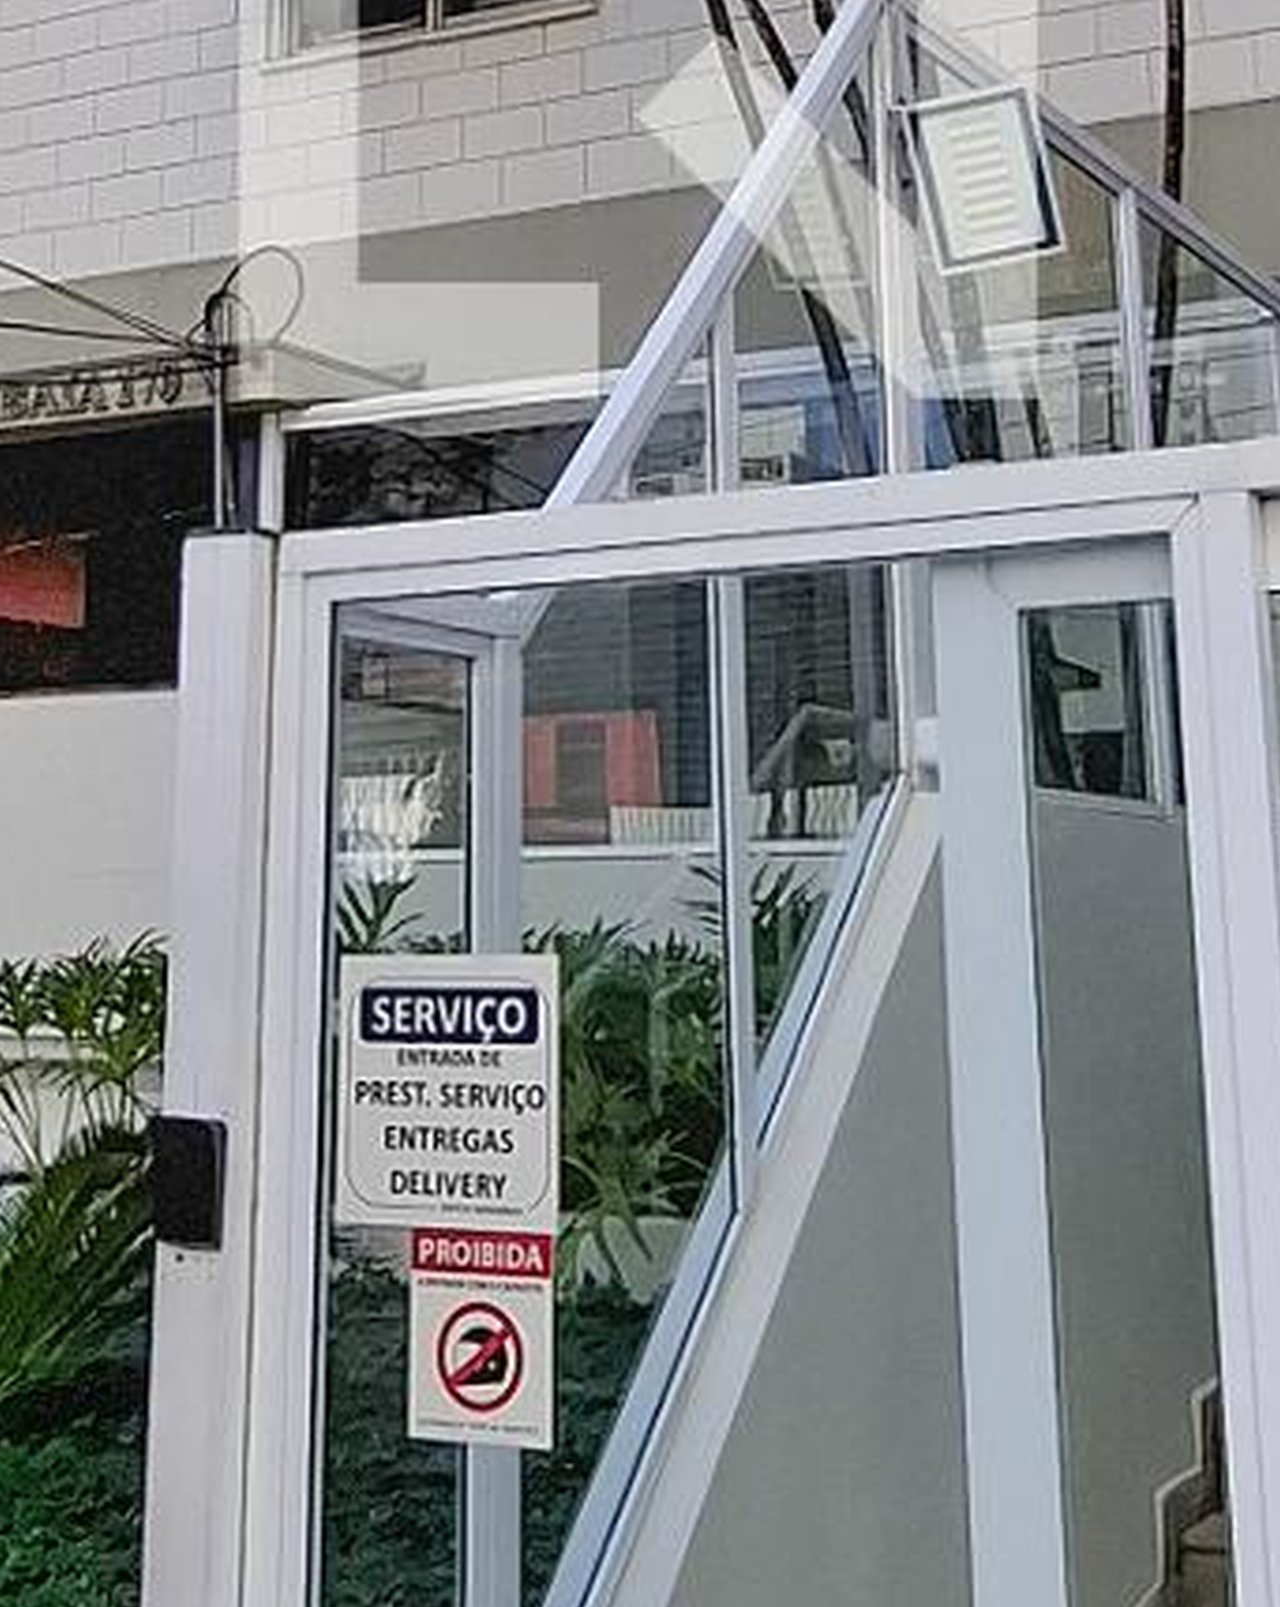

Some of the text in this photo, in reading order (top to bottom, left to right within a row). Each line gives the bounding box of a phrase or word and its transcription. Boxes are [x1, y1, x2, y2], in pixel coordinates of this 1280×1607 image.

[372, 995, 526, 1044] SERVIÇO
[397, 1047, 503, 1068] ENTRADA DE
[354, 1080, 545, 1115] PREST. SERVIÇO
[384, 1126, 514, 1154] ENTREGAS
[390, 1170, 507, 1199] DELIVERY
[418, 1237, 545, 1273] PROIBIDA
